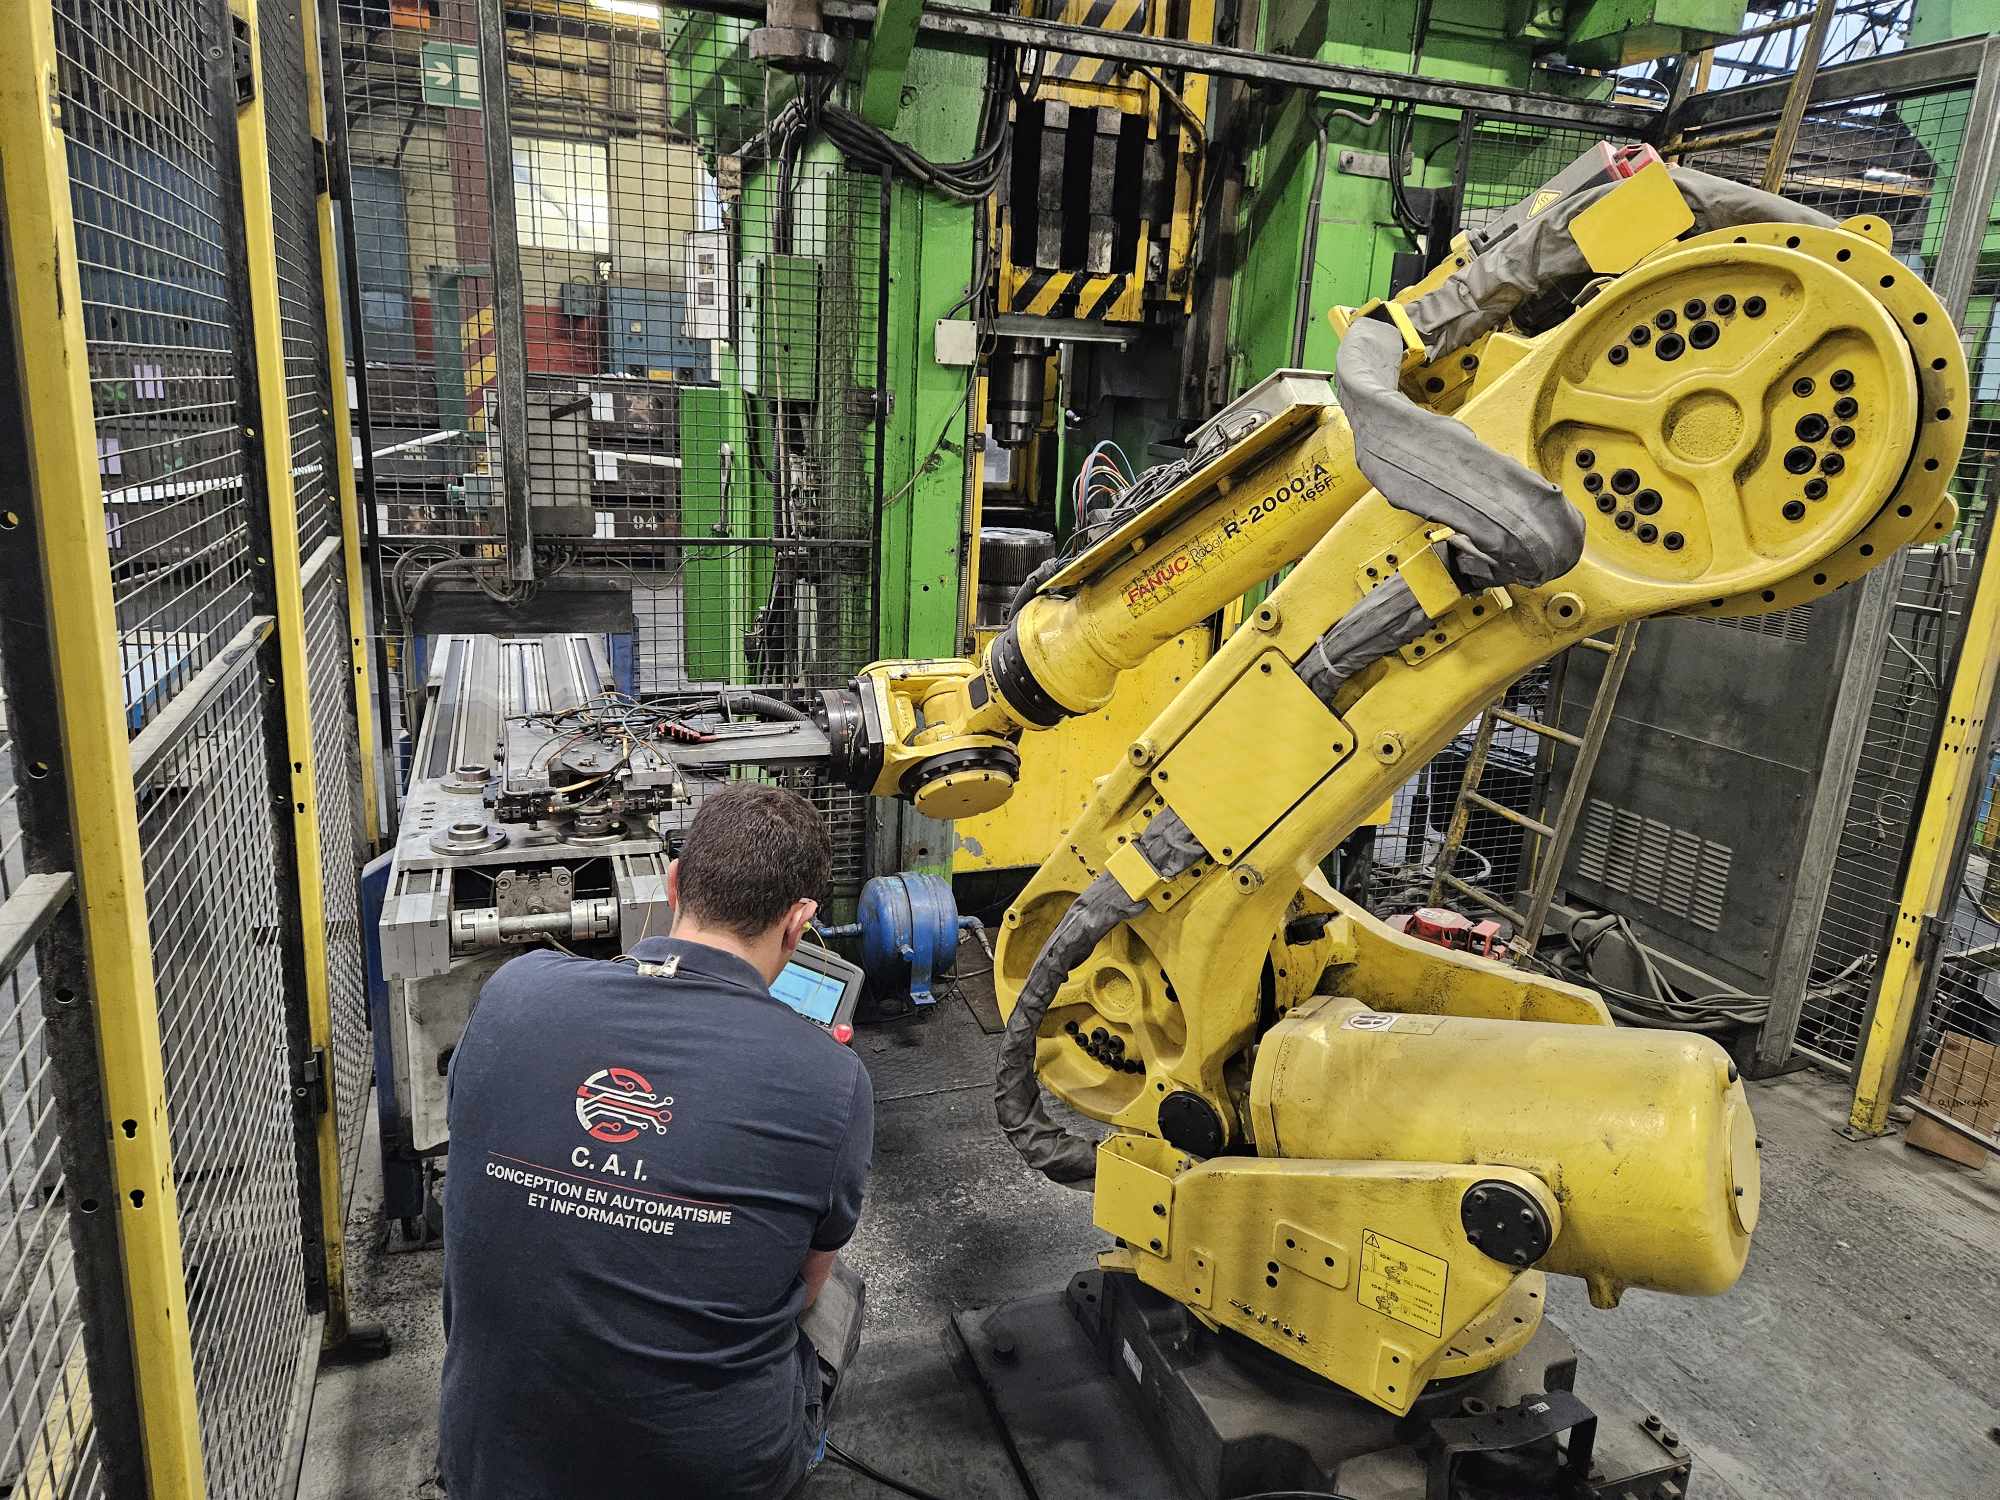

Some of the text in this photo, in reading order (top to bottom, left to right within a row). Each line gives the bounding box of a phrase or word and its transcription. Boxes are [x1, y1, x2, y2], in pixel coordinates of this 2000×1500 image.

[1300, 475, 1333, 502] 165F
[632, 514, 658, 531] 94
[1127, 556, 1189, 604] FANUC
[1190, 536, 1223, 562] Robot
[570, 1146, 648, 1181] C. A. I.
[485, 1162, 732, 1225] CONCEPTION EN AUTOMATISME
[527, 1193, 675, 1236] ET INFORMATIQUE
